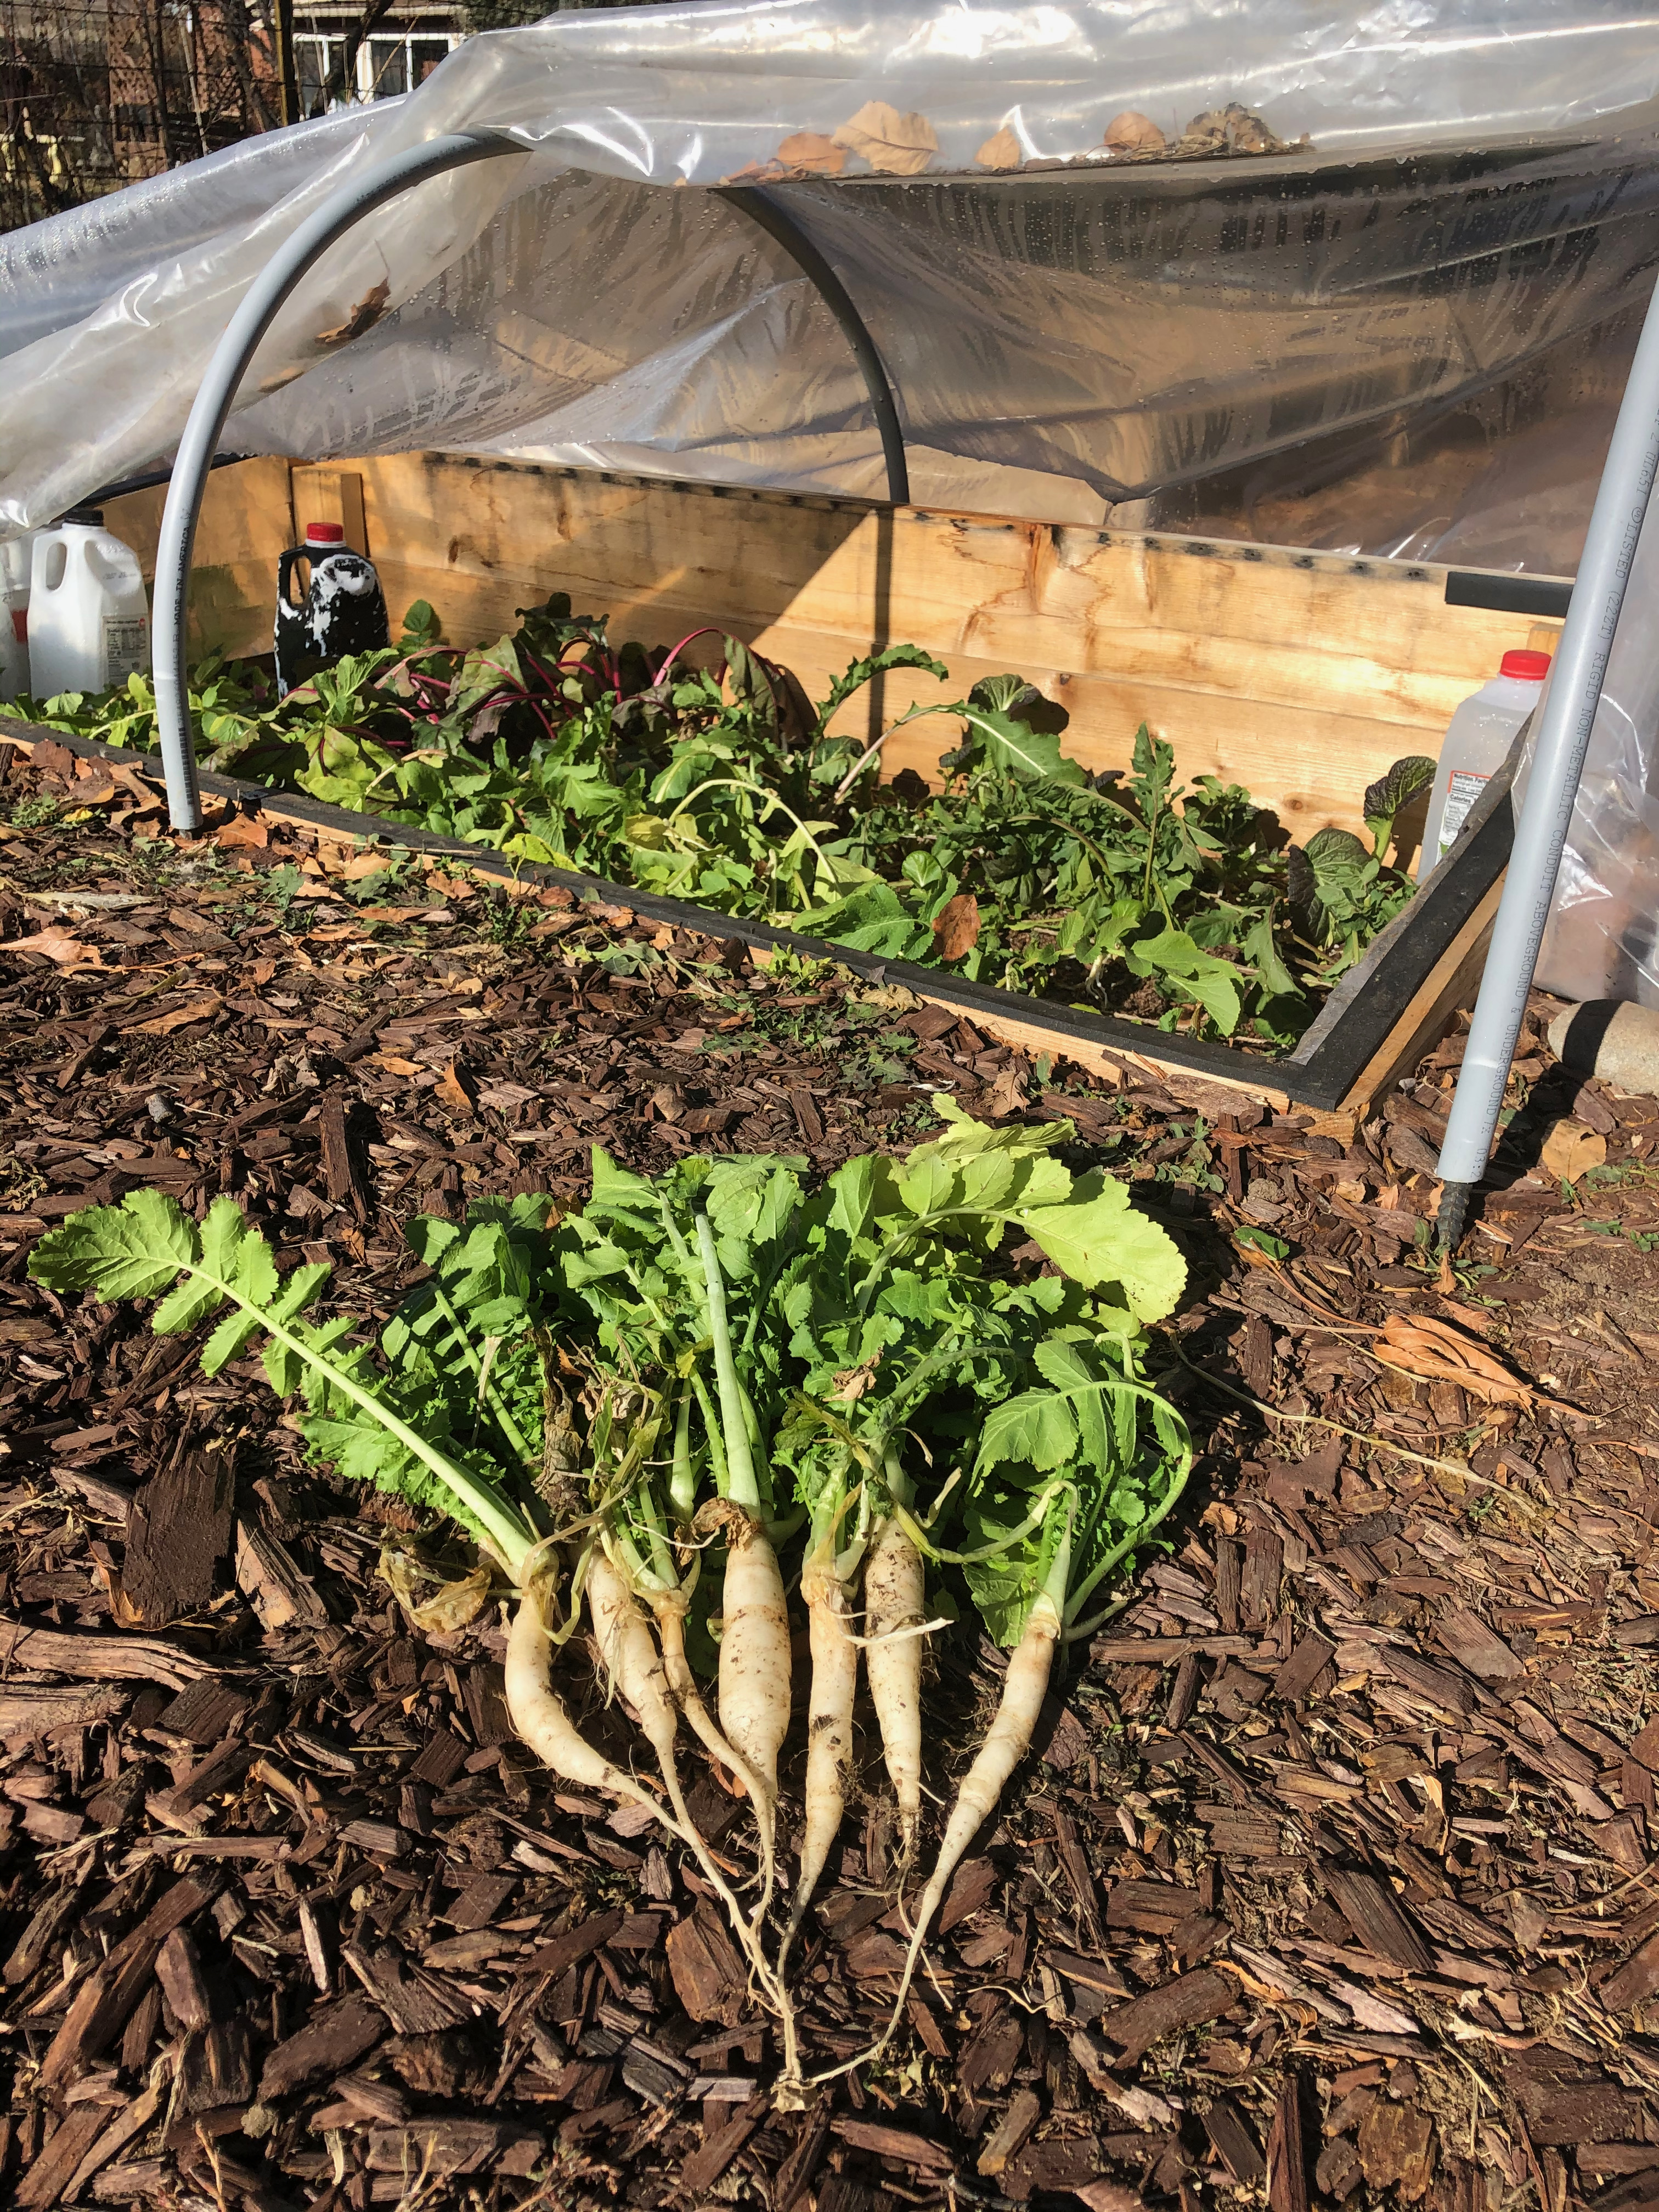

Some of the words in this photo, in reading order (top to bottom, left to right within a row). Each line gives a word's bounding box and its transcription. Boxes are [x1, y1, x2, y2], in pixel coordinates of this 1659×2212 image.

[1637, 451, 1656, 495] UL651
[176, 578, 184, 591] IN
[1585, 651, 1606, 700] RIGID
[1557, 708, 1593, 820] NON-METALLIC
[1540, 830, 1563, 892] CONDUIT
[1515, 900, 1547, 998] ABOVEGROUND
[1486, 1024, 1517, 1116] UNDERGROUND
